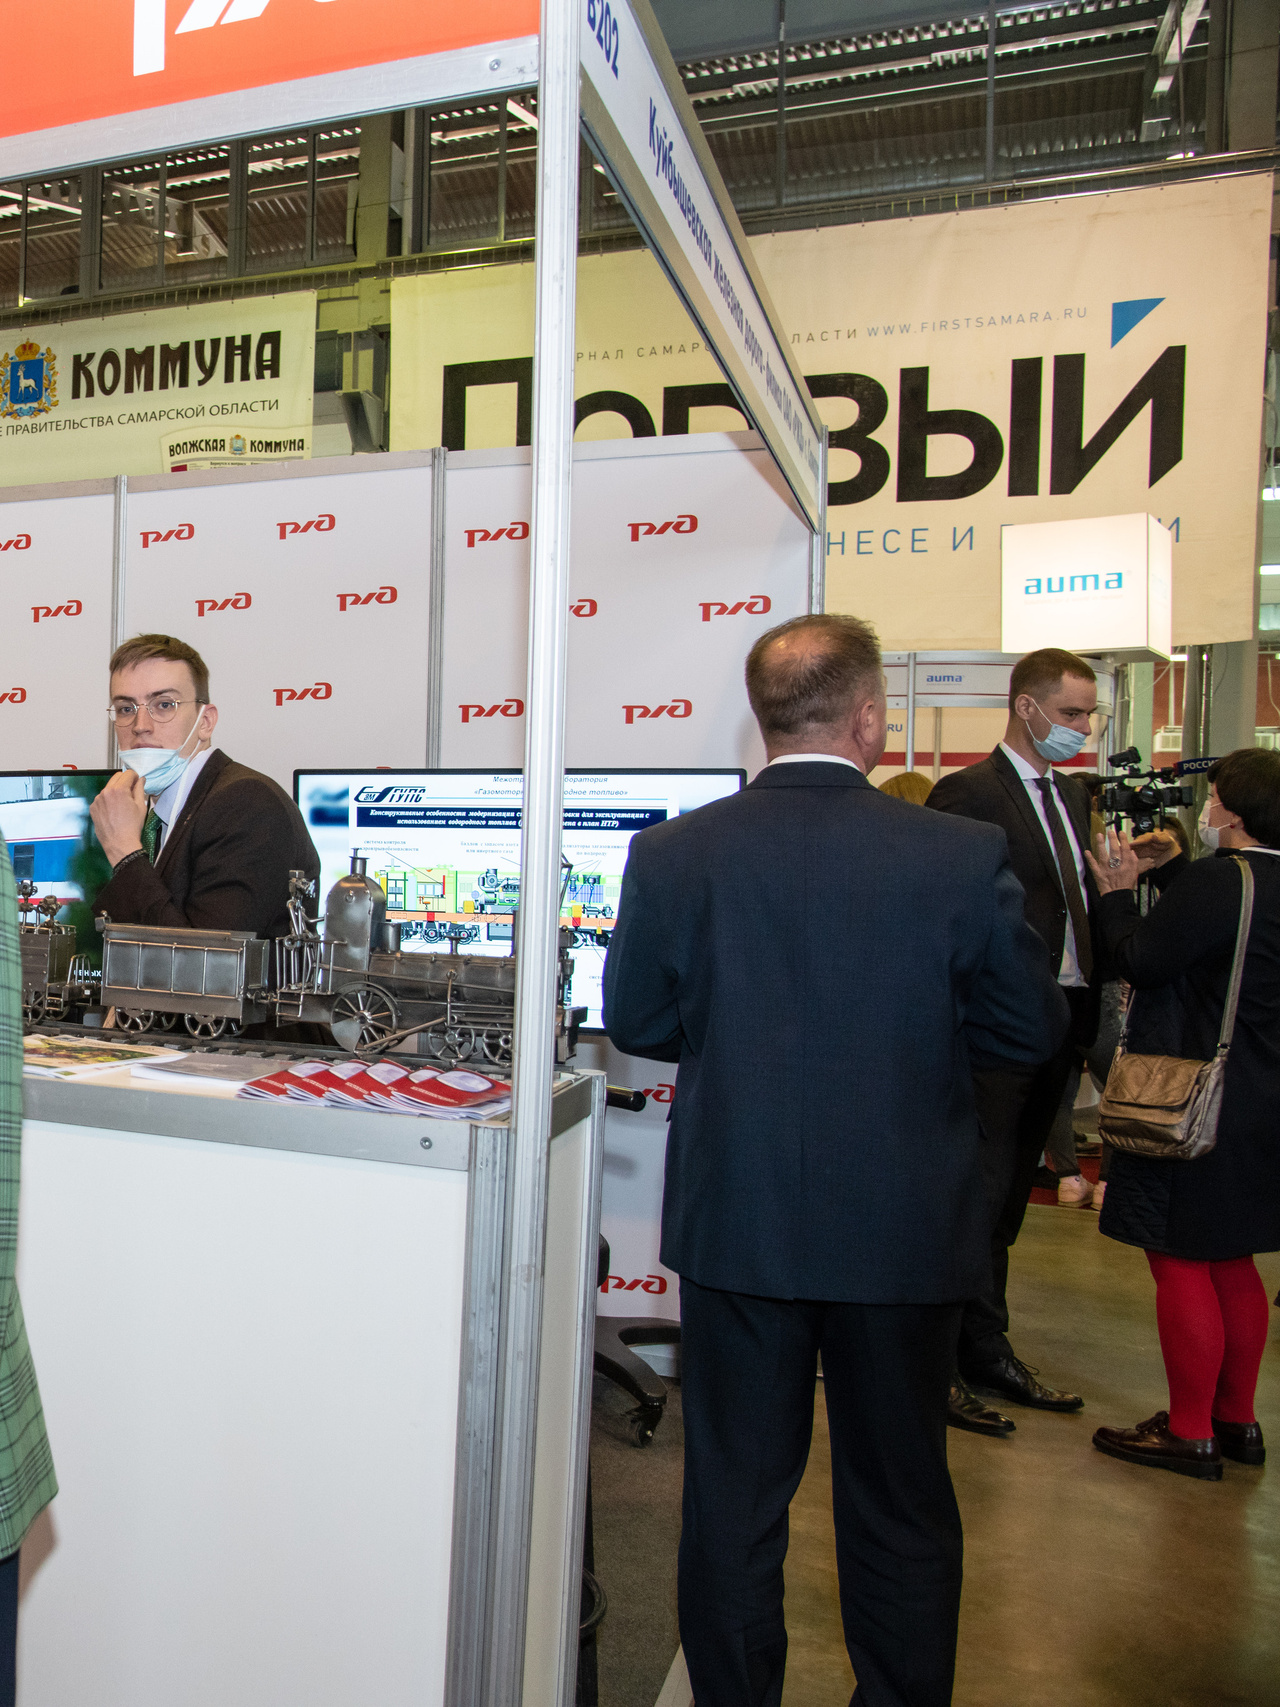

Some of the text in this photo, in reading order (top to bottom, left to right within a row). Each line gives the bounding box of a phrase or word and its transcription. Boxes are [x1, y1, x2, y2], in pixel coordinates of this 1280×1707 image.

[649, 97, 712, 271] Куйбышевская
[576, 349, 625, 362] РНАЛ
[791, 328, 857, 345] ЛАСТИ
[867, 307, 1088, 338] WWW.FIRSTSAMARA.RU
[71, 330, 282, 399] КОММУНА
[6, 415, 114, 436] ПРАВИТЕЛЬСТВА
[117, 404, 205, 424] САМАРСКОЙ
[209, 399, 279, 417] ОБЛАСТИ
[169, 438, 304, 457] ВОЛЖСКАЯ КОММУНА
[825, 526, 929, 556] НЕСЕ
[1024, 572, 1123, 595] auma
[1183, 760, 1218, 770] РОССИ
[474, 788, 524, 796] «Газомотор
[564, 776, 608, 784] боратория
